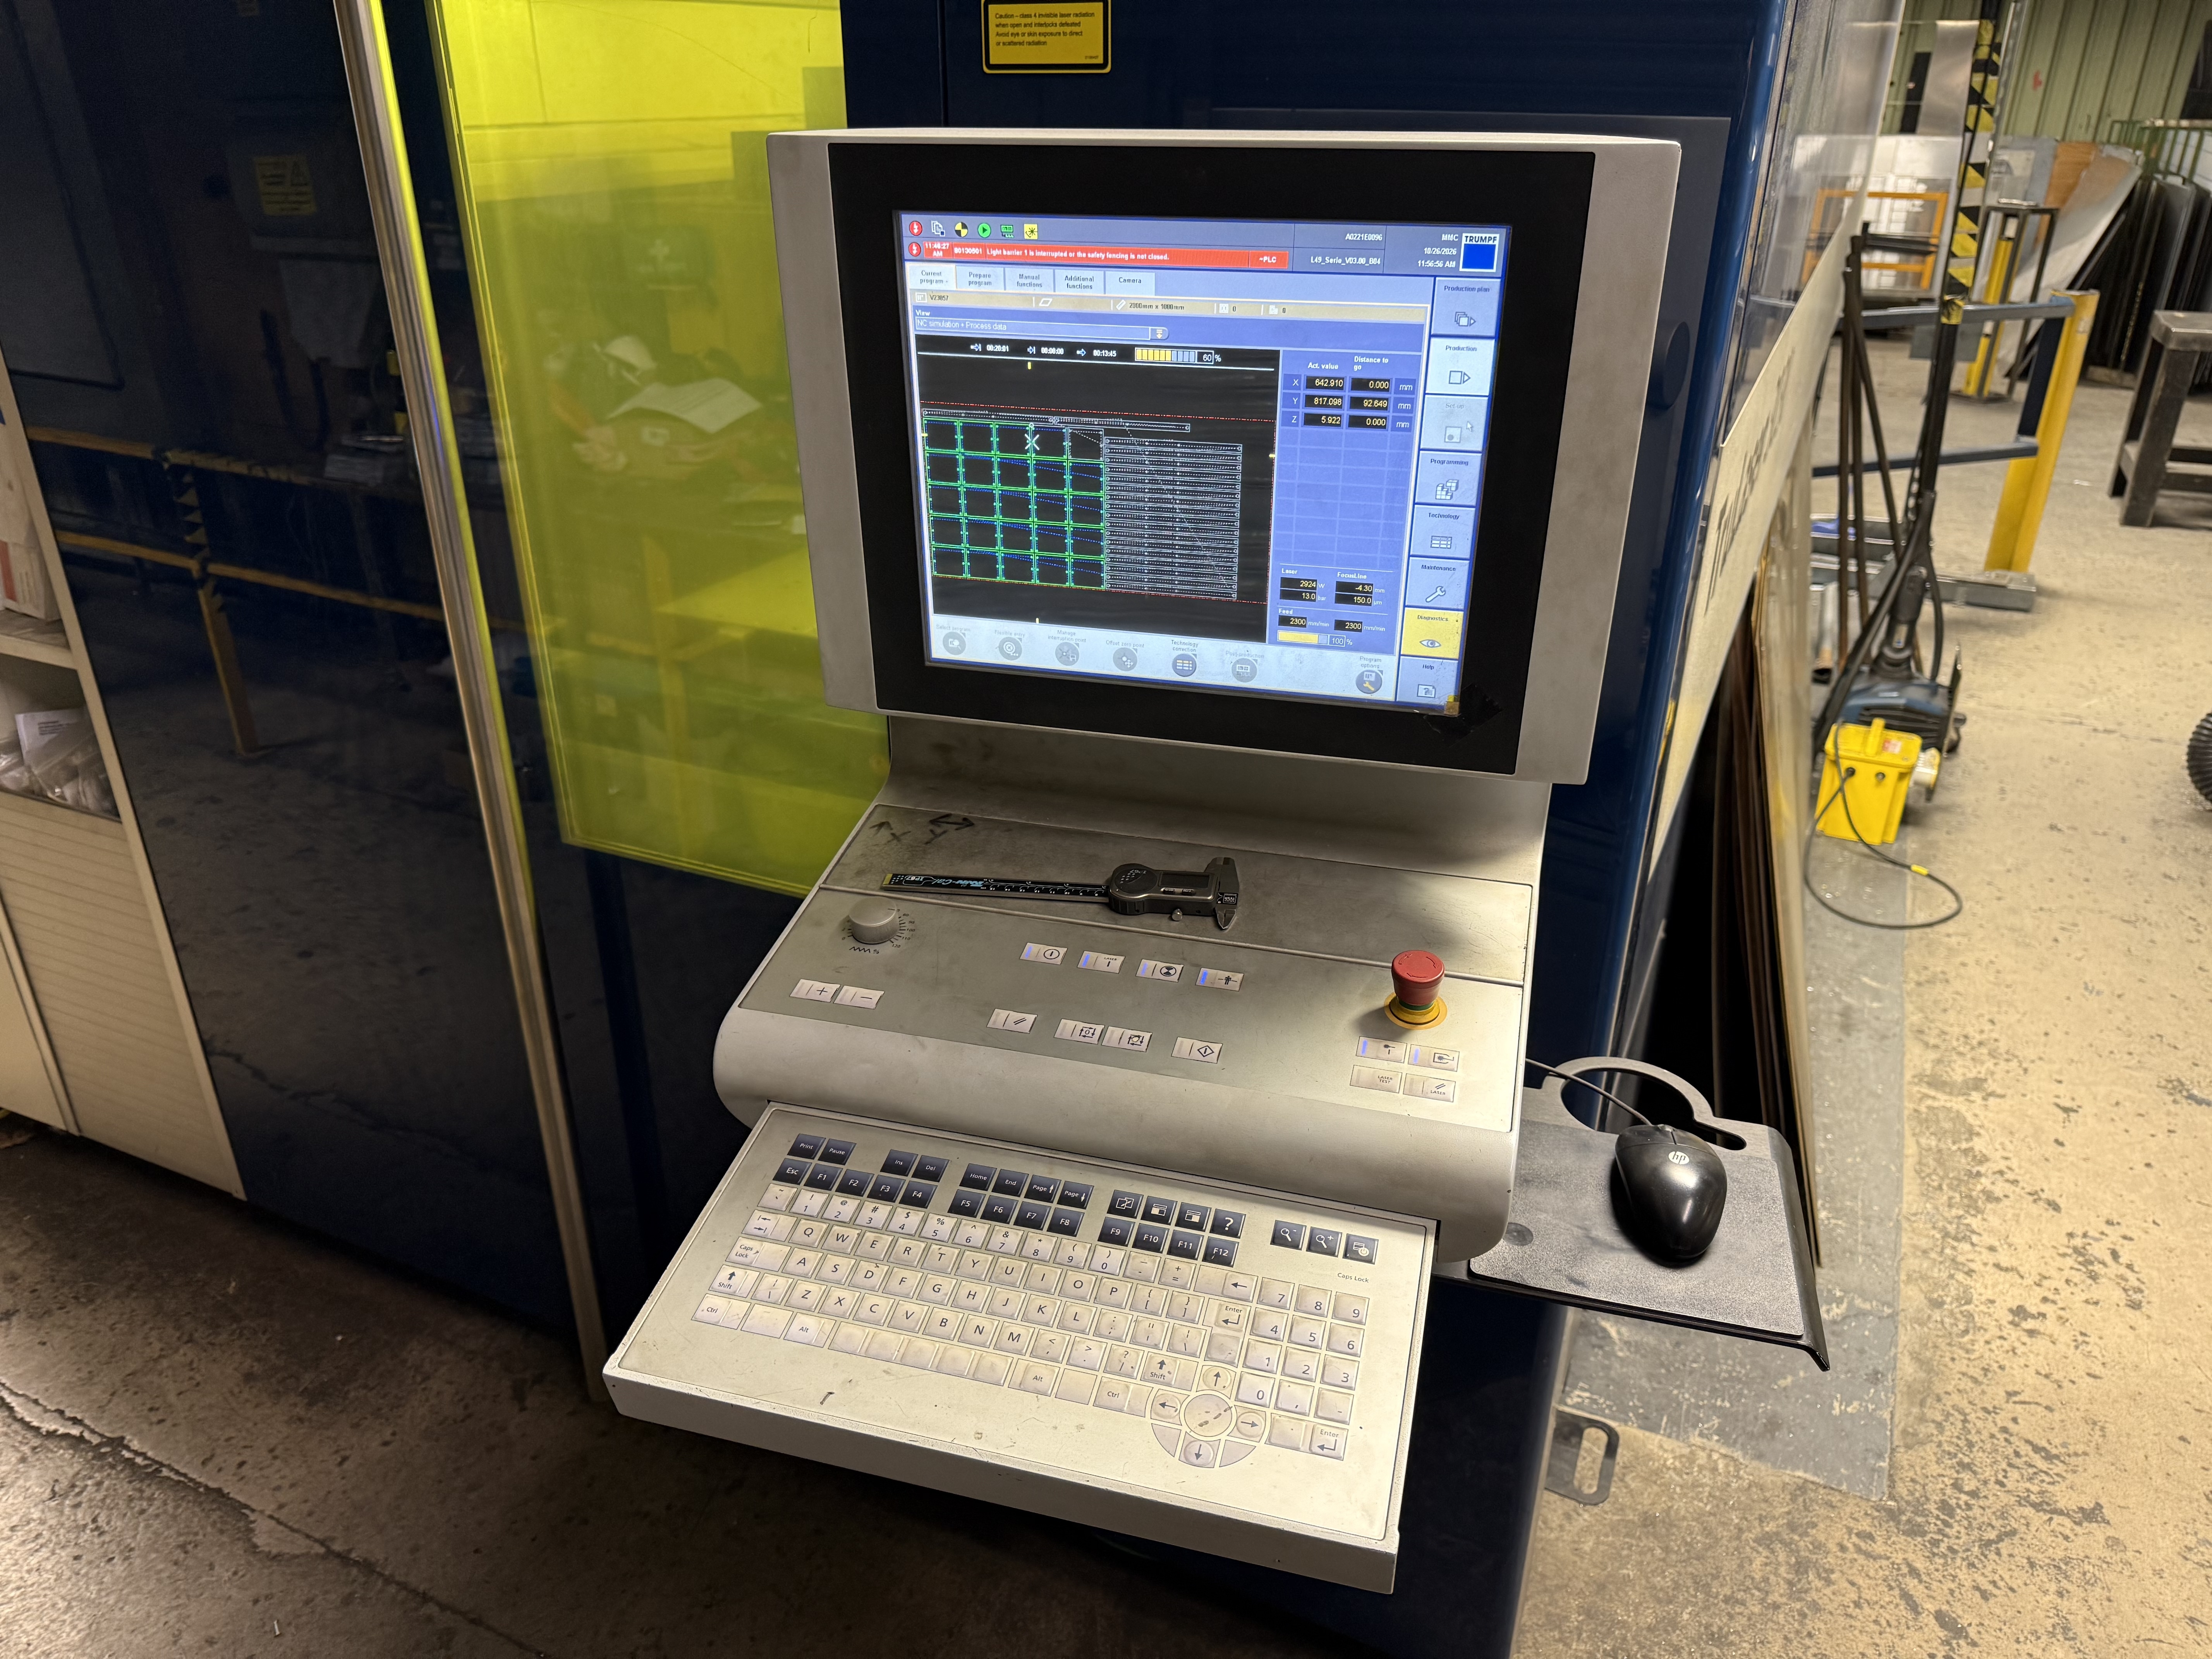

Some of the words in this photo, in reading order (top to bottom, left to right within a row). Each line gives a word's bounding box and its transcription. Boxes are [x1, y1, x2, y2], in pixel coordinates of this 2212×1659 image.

[1106, 252, 1128, 261] fencing
[929, 320, 959, 328] simulation
[966, 321, 991, 330] Process
[1093, 349, 1117, 357] 00:13:45
[1369, 380, 1389, 389] 0.000
[1314, 397, 1342, 406] 817.098
[1363, 399, 1388, 407] 92.649
[1321, 416, 1341, 424] 5.922
[1366, 417, 1386, 426] 0.000
[1430, 458, 1469, 466] Programming
[1428, 512, 1460, 520] Technology
[1421, 564, 1456, 572] Maintenance
[1337, 572, 1367, 580] FocusLine
[1353, 596, 1372, 605] 150.0
[1171, 639, 1199, 648] Technology
[1213, 1247, 1229, 1257] F12
[1338, 1272, 1353, 1281] Caps
[1225, 1305, 1243, 1314] Enter
[1320, 1429, 1340, 1438] Enter
